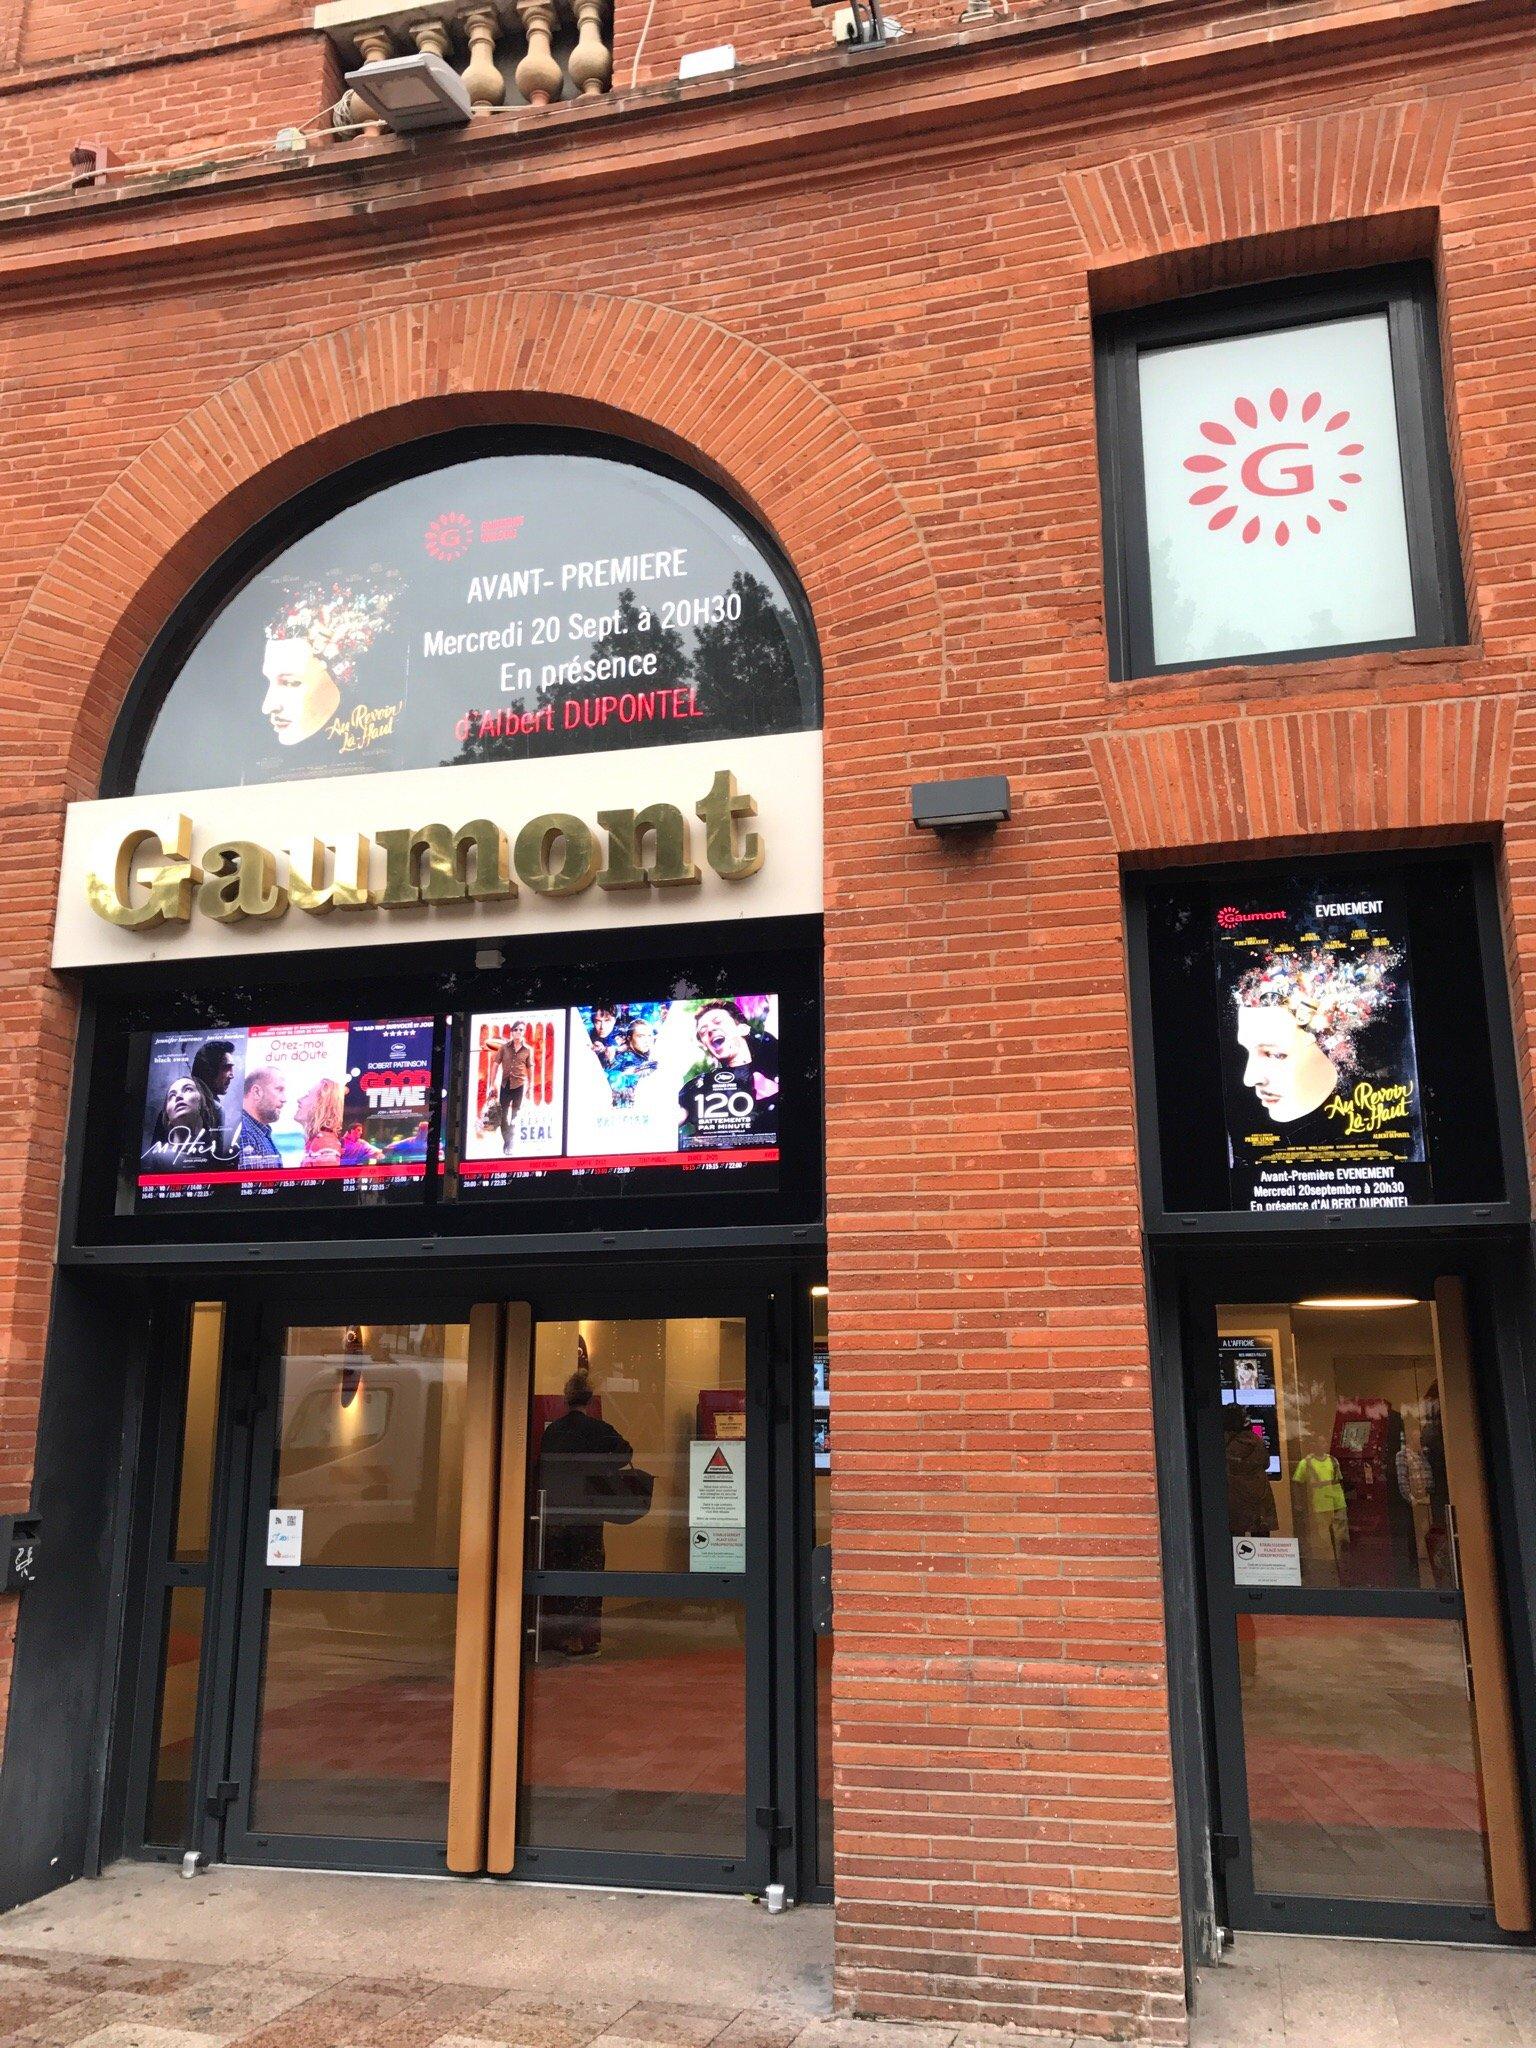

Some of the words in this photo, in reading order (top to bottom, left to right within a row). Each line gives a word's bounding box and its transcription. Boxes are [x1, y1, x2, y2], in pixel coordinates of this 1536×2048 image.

[1241, 443, 1314, 496] G
[467, 568, 555, 604] AVANT-
[561, 549, 688, 591] PREMIERE
[424, 622, 523, 657] Mercredi
[531, 616, 560, 646] 20
[568, 609, 628, 642] Sept.
[637, 605, 652, 632] à
[661, 593, 742, 630] 20H30
[500, 662, 532, 692] En
[541, 653, 658, 693] présence
[454, 703, 555, 743] d'Albert
[564, 687, 703, 730] DUPONTEL
[86, 768, 767, 933] Gaumont
[1224, 909, 1287, 923] Gaumont
[1315, 900, 1384, 918] EVENEMENT
[393, 1060, 427, 1068] PATTINSON
[360, 1069, 431, 1092] GOOD
[366, 1085, 426, 1109] TIME
[694, 1091, 754, 1119] 120
[1324, 1095, 1355, 1119] Au
[1354, 1080, 1414, 1110] Revoir
[520, 1126, 552, 1140] SEAL
[717, 1122, 751, 1130] MINUTE
[1260, 1169, 1334, 1183] Avant-Première
[1336, 1166, 1395, 1180] EVENEMENT
[1253, 1185, 1296, 1197] Mercredi
[1298, 1183, 1362, 1198] 20septembre
[1364, 1182, 1371, 1194] à
[1373, 1181, 1405, 1194] 20h30
[1250, 1201, 1263, 1212] En
[1265, 1200, 1309, 1211] présence
